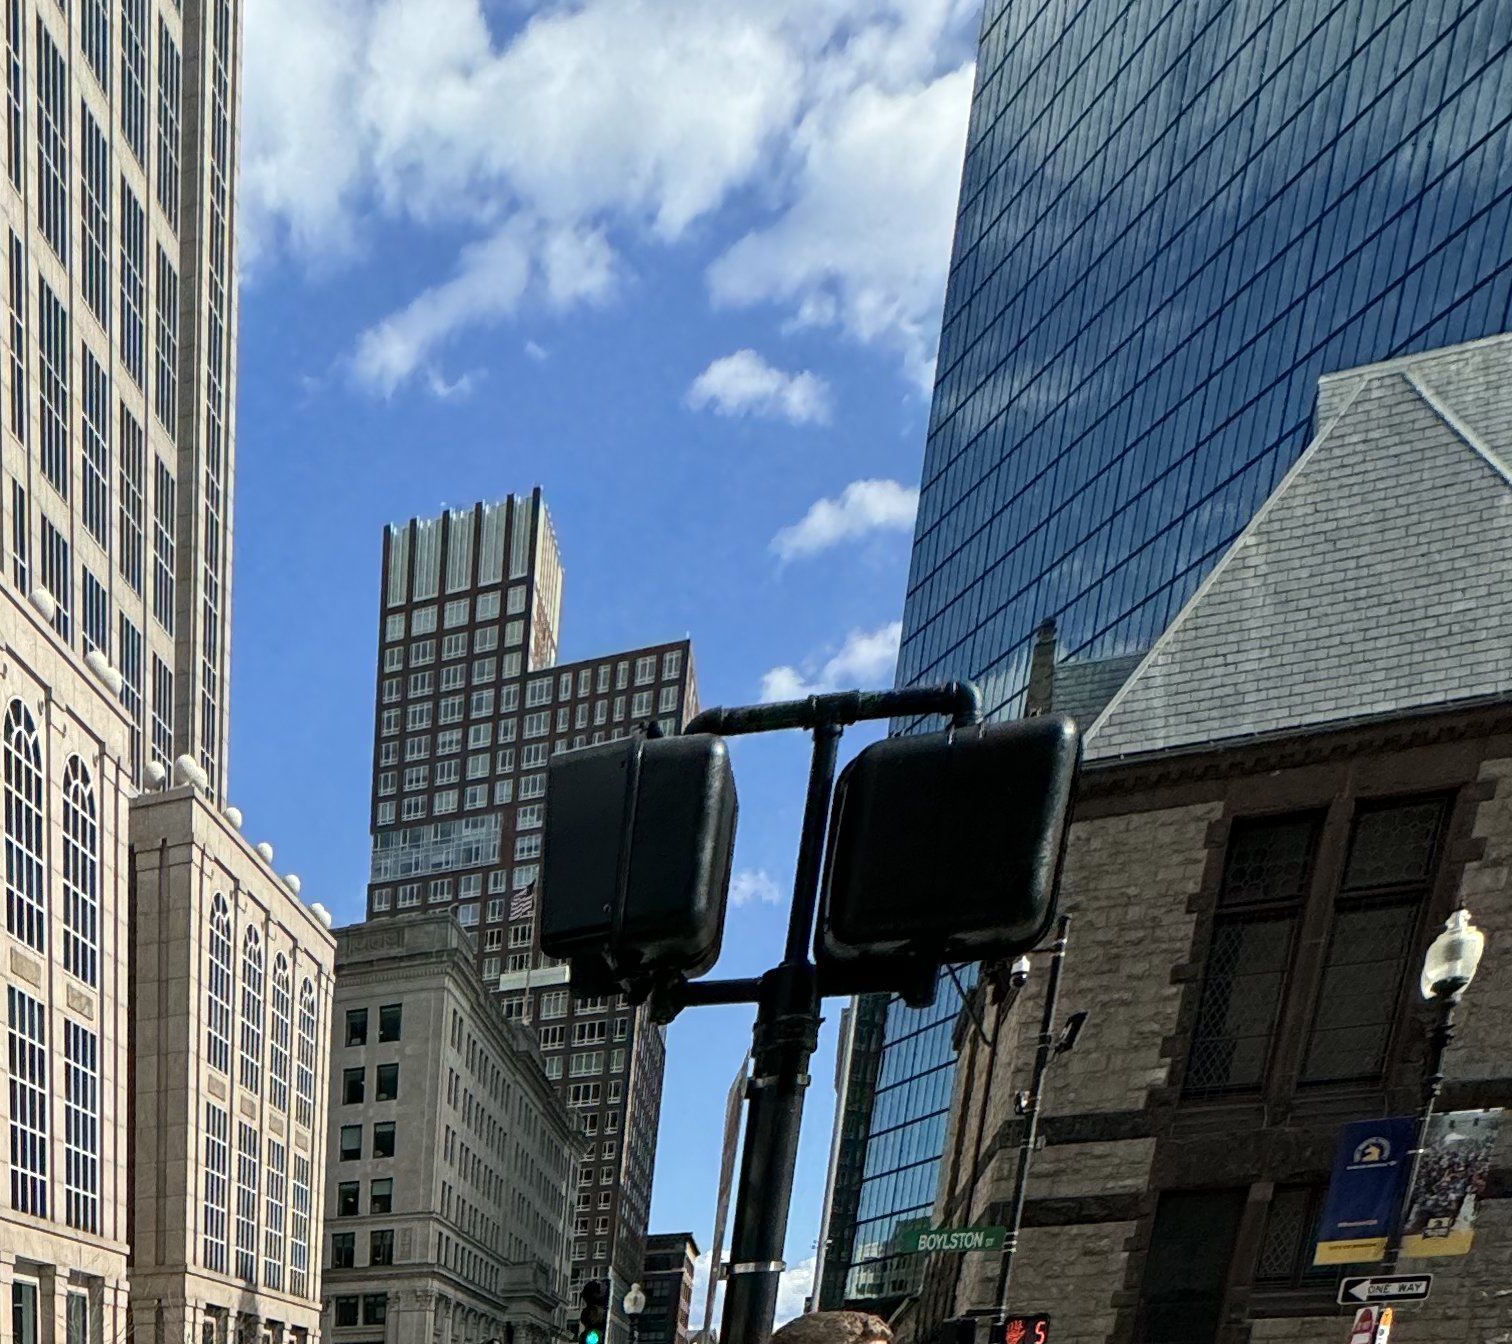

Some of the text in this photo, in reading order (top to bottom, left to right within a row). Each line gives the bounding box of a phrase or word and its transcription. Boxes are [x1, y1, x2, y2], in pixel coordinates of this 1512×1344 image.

[918, 1232, 984, 1250] BOYLSTON
[1368, 1283, 1423, 1295] ONE WAY
